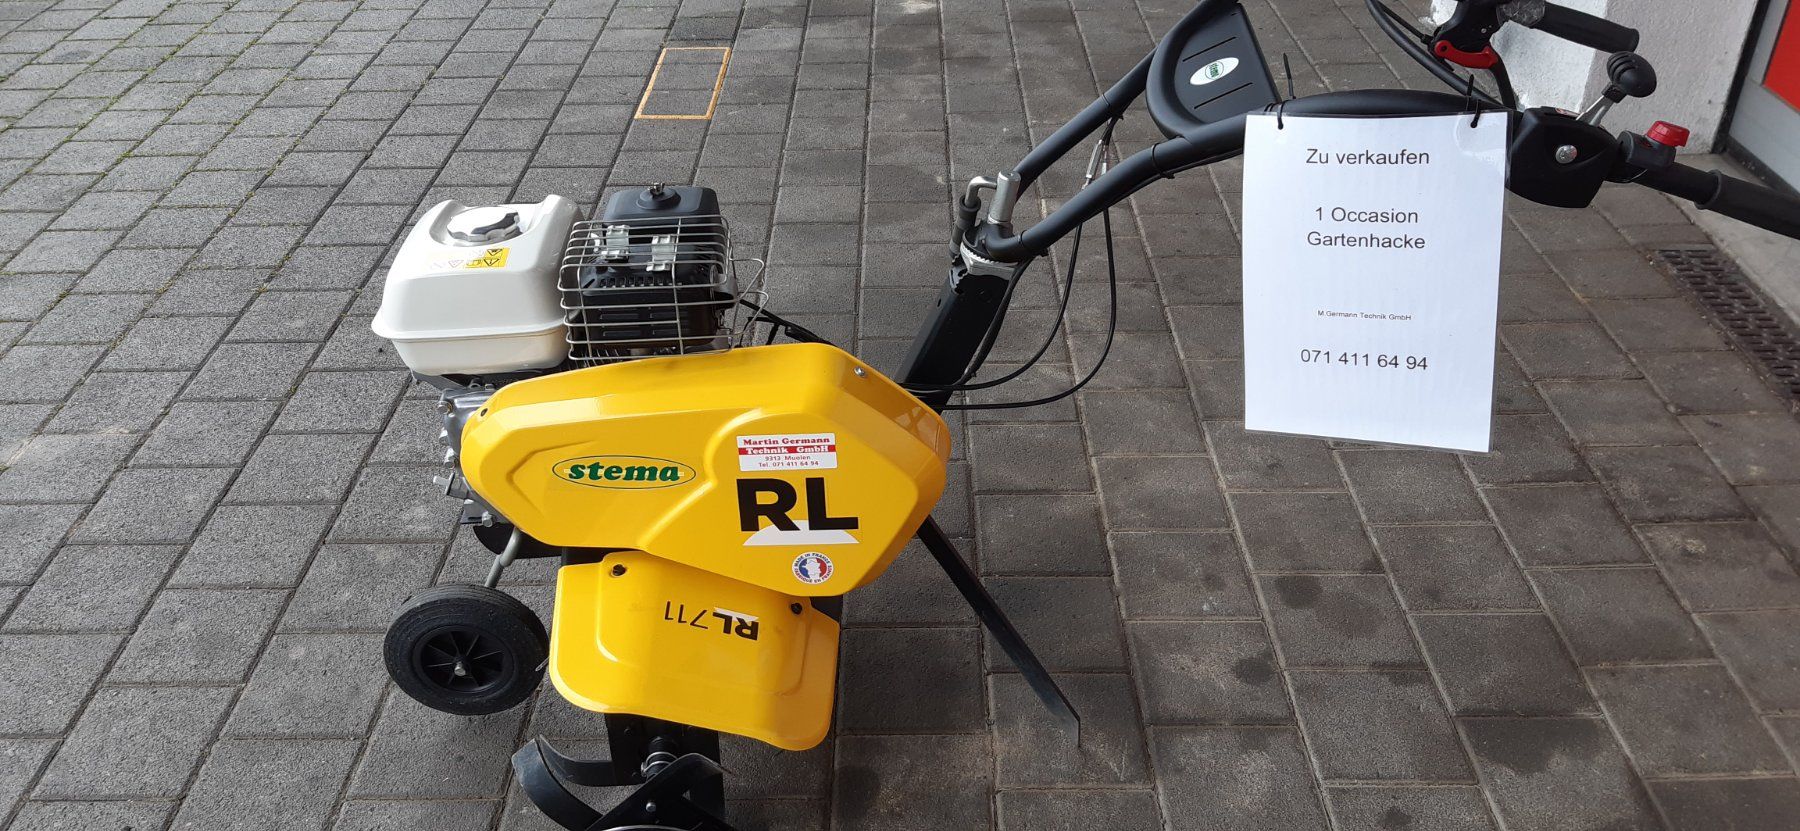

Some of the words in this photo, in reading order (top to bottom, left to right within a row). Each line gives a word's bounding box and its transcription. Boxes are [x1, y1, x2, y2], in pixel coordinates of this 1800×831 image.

[1306, 148, 1329, 164] Zu
[1336, 149, 1430, 165] verkaufen
[1315, 206, 1322, 221] 1
[1331, 207, 1418, 223] Occasion
[1307, 231, 1426, 249] Gartenhacke
[1360, 311, 1387, 320] Technik
[1389, 313, 1412, 321] GmbH
[1300, 349, 1330, 364] 071
[1338, 352, 1369, 367] 411
[1377, 354, 1399, 368] 64
[1406, 355, 1428, 370] 94
[743, 438, 779, 446] Martin
[781, 437, 830, 445] Germann
[745, 446, 789, 455] Technik
[796, 445, 829, 453] GmbH
[568, 461, 681, 482] stema
[736, 477, 859, 532] RL
